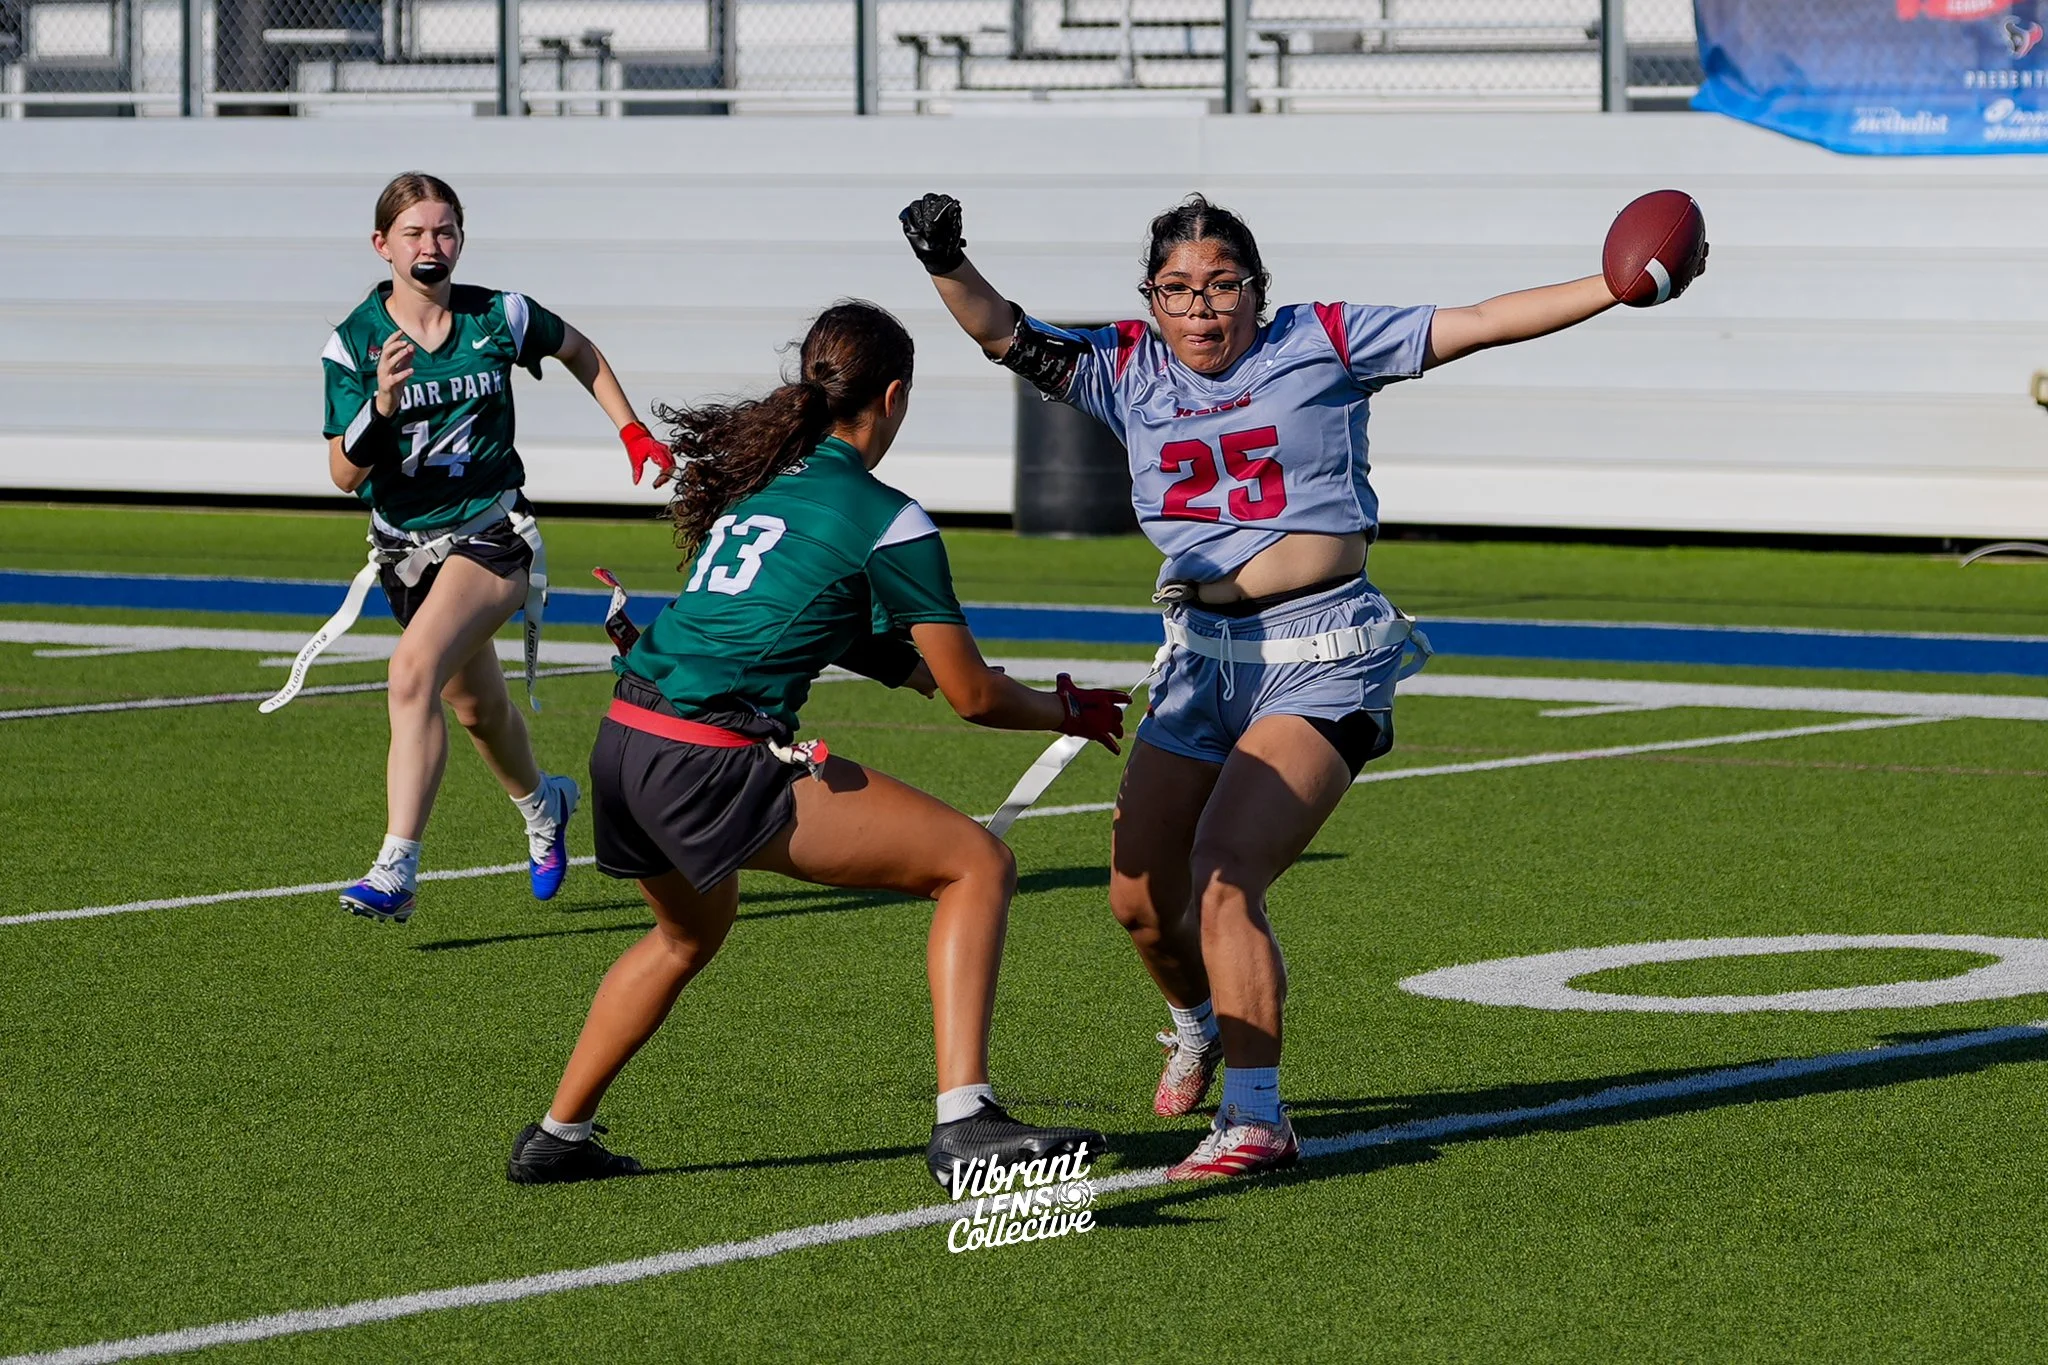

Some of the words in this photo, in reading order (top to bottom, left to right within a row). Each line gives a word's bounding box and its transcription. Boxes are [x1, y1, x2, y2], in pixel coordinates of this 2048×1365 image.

[374, 380, 443, 410] DAR
[449, 370, 503, 401] PARK
[401, 414, 478, 477] 14
[1159, 425, 1288, 522] 25
[685, 514, 787, 596] 13
